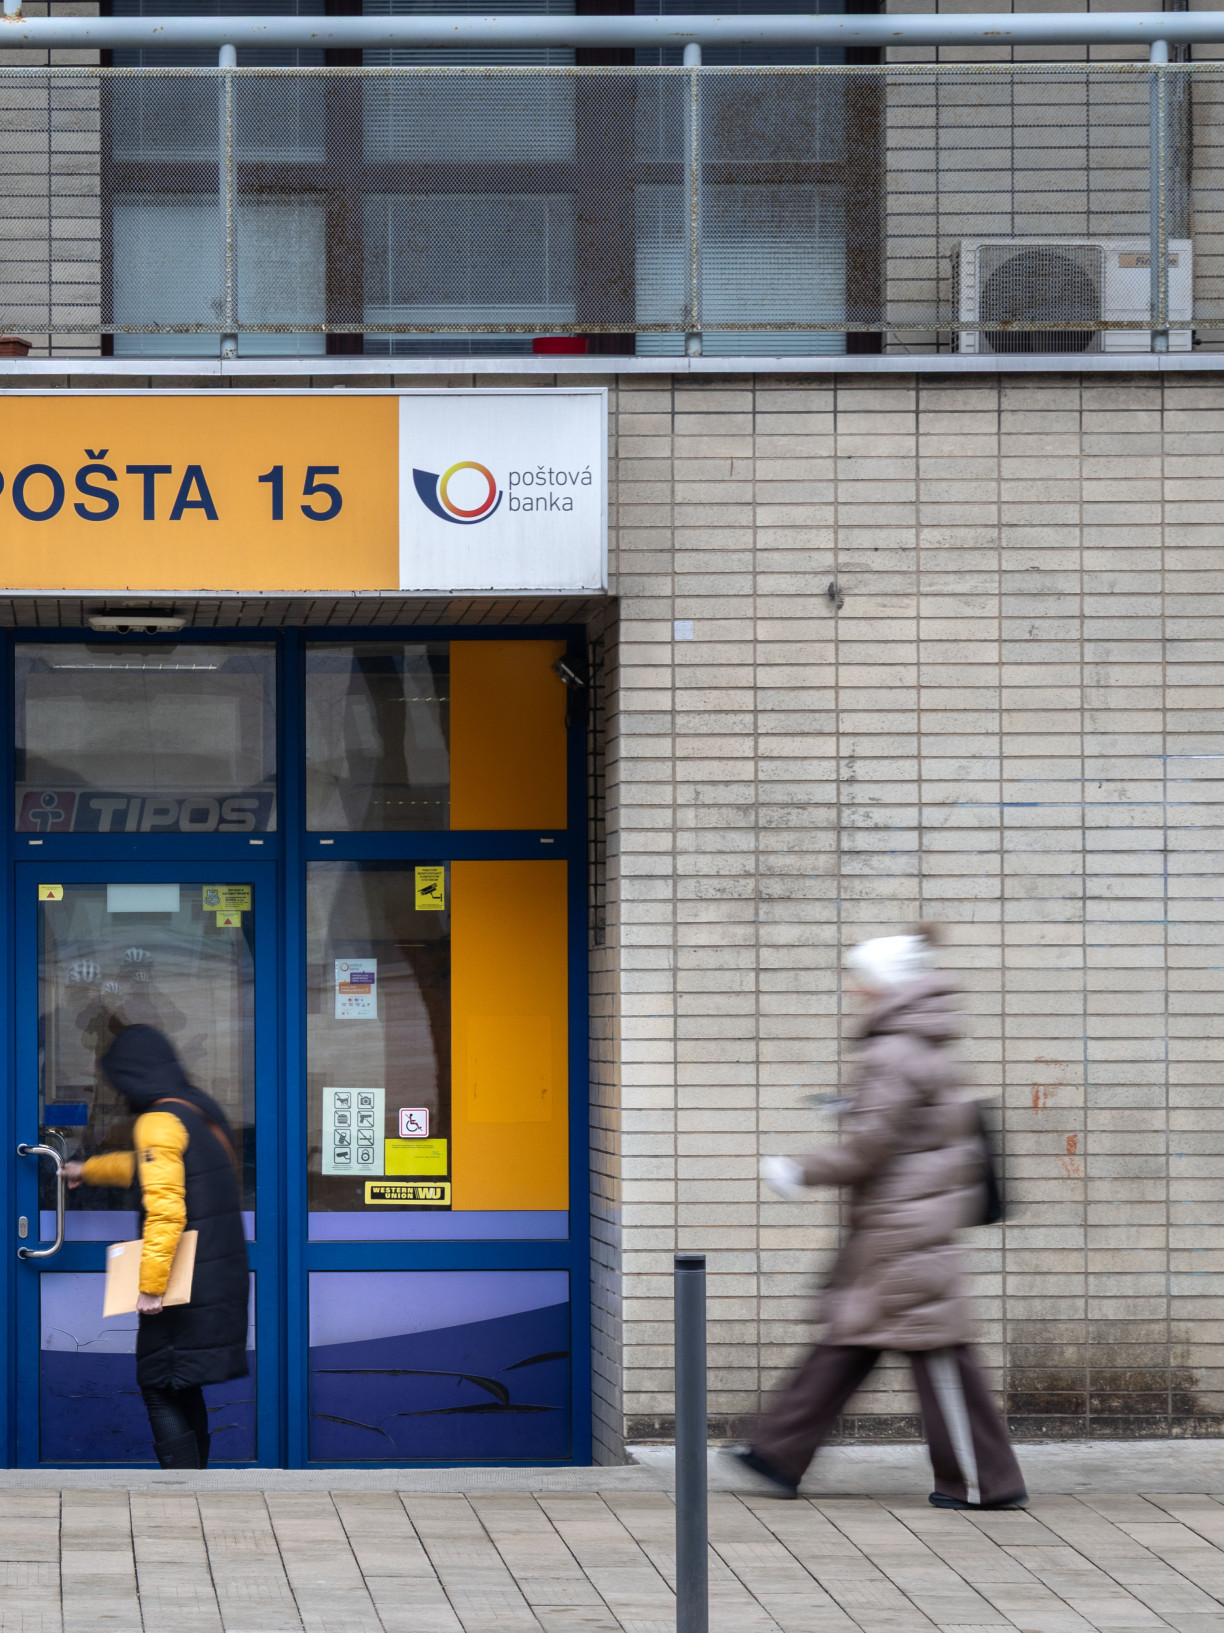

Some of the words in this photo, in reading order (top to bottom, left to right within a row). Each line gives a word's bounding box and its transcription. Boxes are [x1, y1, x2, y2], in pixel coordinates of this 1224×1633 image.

[509, 466, 592, 489] poštová
[258, 465, 343, 522] 15
[509, 492, 573, 512] banka
[89, 798, 260, 832] TIPOS
[417, 1187, 442, 1199] WU
